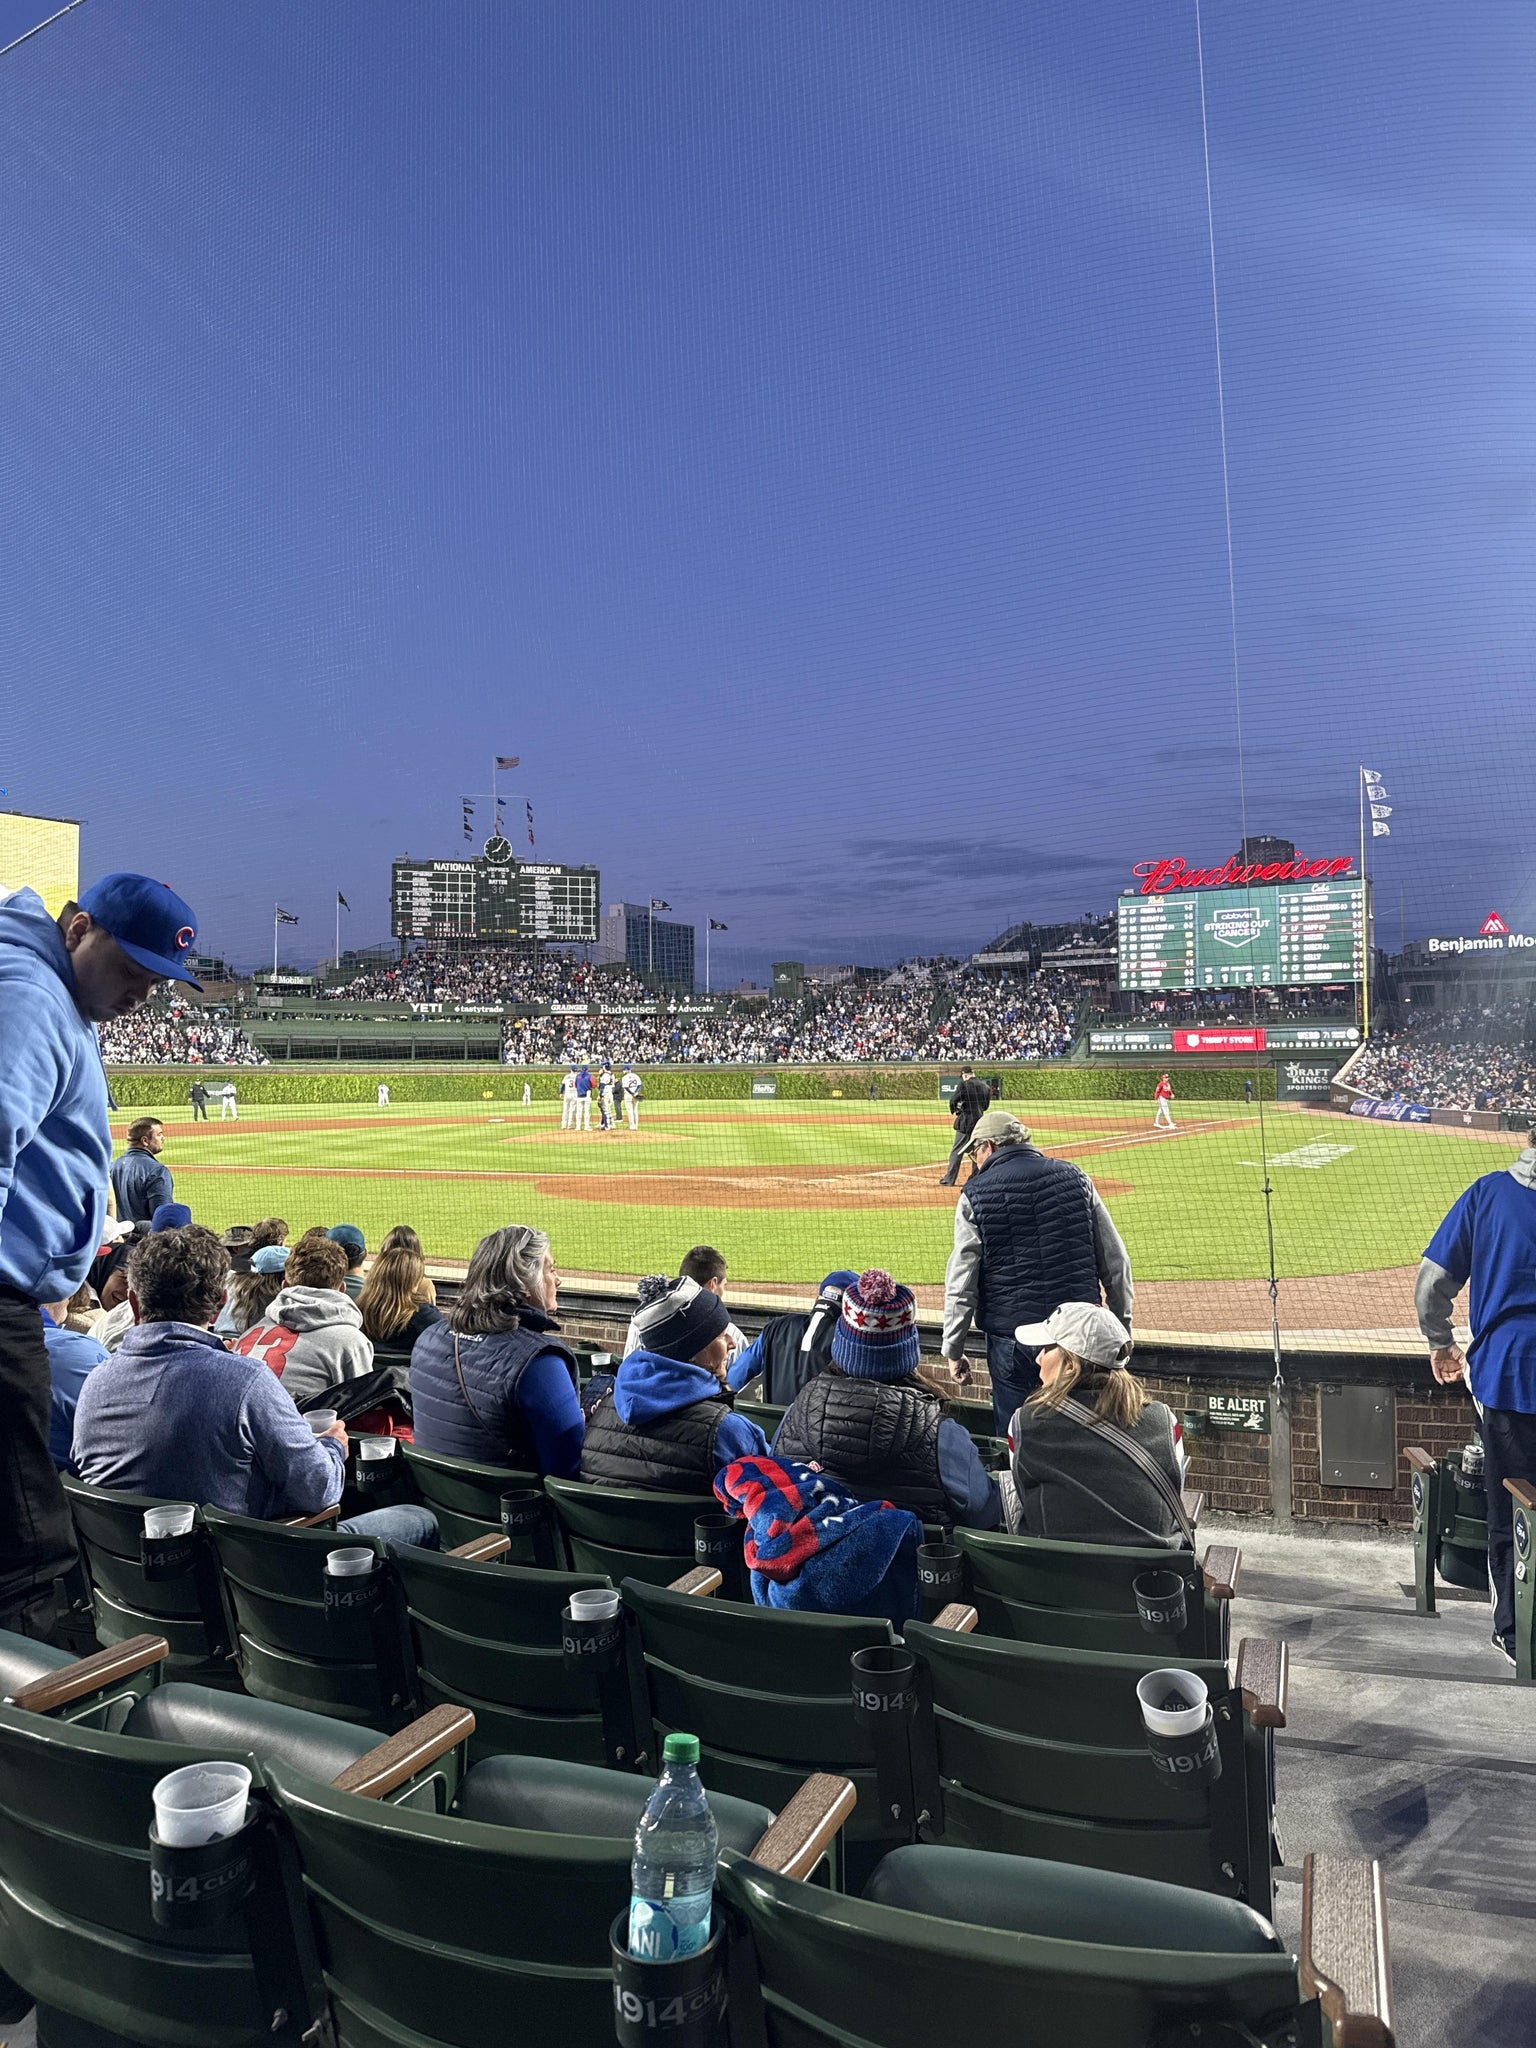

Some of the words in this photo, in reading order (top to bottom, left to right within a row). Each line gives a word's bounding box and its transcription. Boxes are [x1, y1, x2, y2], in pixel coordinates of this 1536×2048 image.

[434, 862, 477, 872] NATIONAL
[520, 865, 561, 874] AMERICAN
[1133, 851, 1352, 893] Budweiser
[492, 886, 505, 894] 30
[1204, 921, 1249, 931] STRIKING
[1250, 920, 1270, 928] OUT
[1218, 928, 1256, 937] CANCER
[175, 926, 195, 950] C
[1428, 936, 1503, 954] Benjamin
[1508, 934, 1536, 948] Mo
[279, 976, 303, 984] Mobile
[1205, 974, 1213, 984] 3
[1221, 973, 1229, 983] 1
[1245, 972, 1253, 982] 2
[1262, 972, 1270, 981] 2
[410, 1003, 443, 1013] YETI
[461, 1005, 504, 1013] tastytrade
[677, 1005, 714, 1013] Advocate
[1229, 1036, 1254, 1044] STORE
[1287, 1068, 1330, 1077] DRAFT
[1292, 1076, 1329, 1084] KINGS
[1208, 1396, 1225, 1410] BE
[1226, 1398, 1266, 1413] ALERT
[920, 1569, 953, 1585] 1914
[1146, 1606, 1181, 1623] 1914
[859, 1690, 904, 1712] 1914
[1167, 1742, 1215, 1773] 1914
[615, 1984, 688, 2028] 1914
